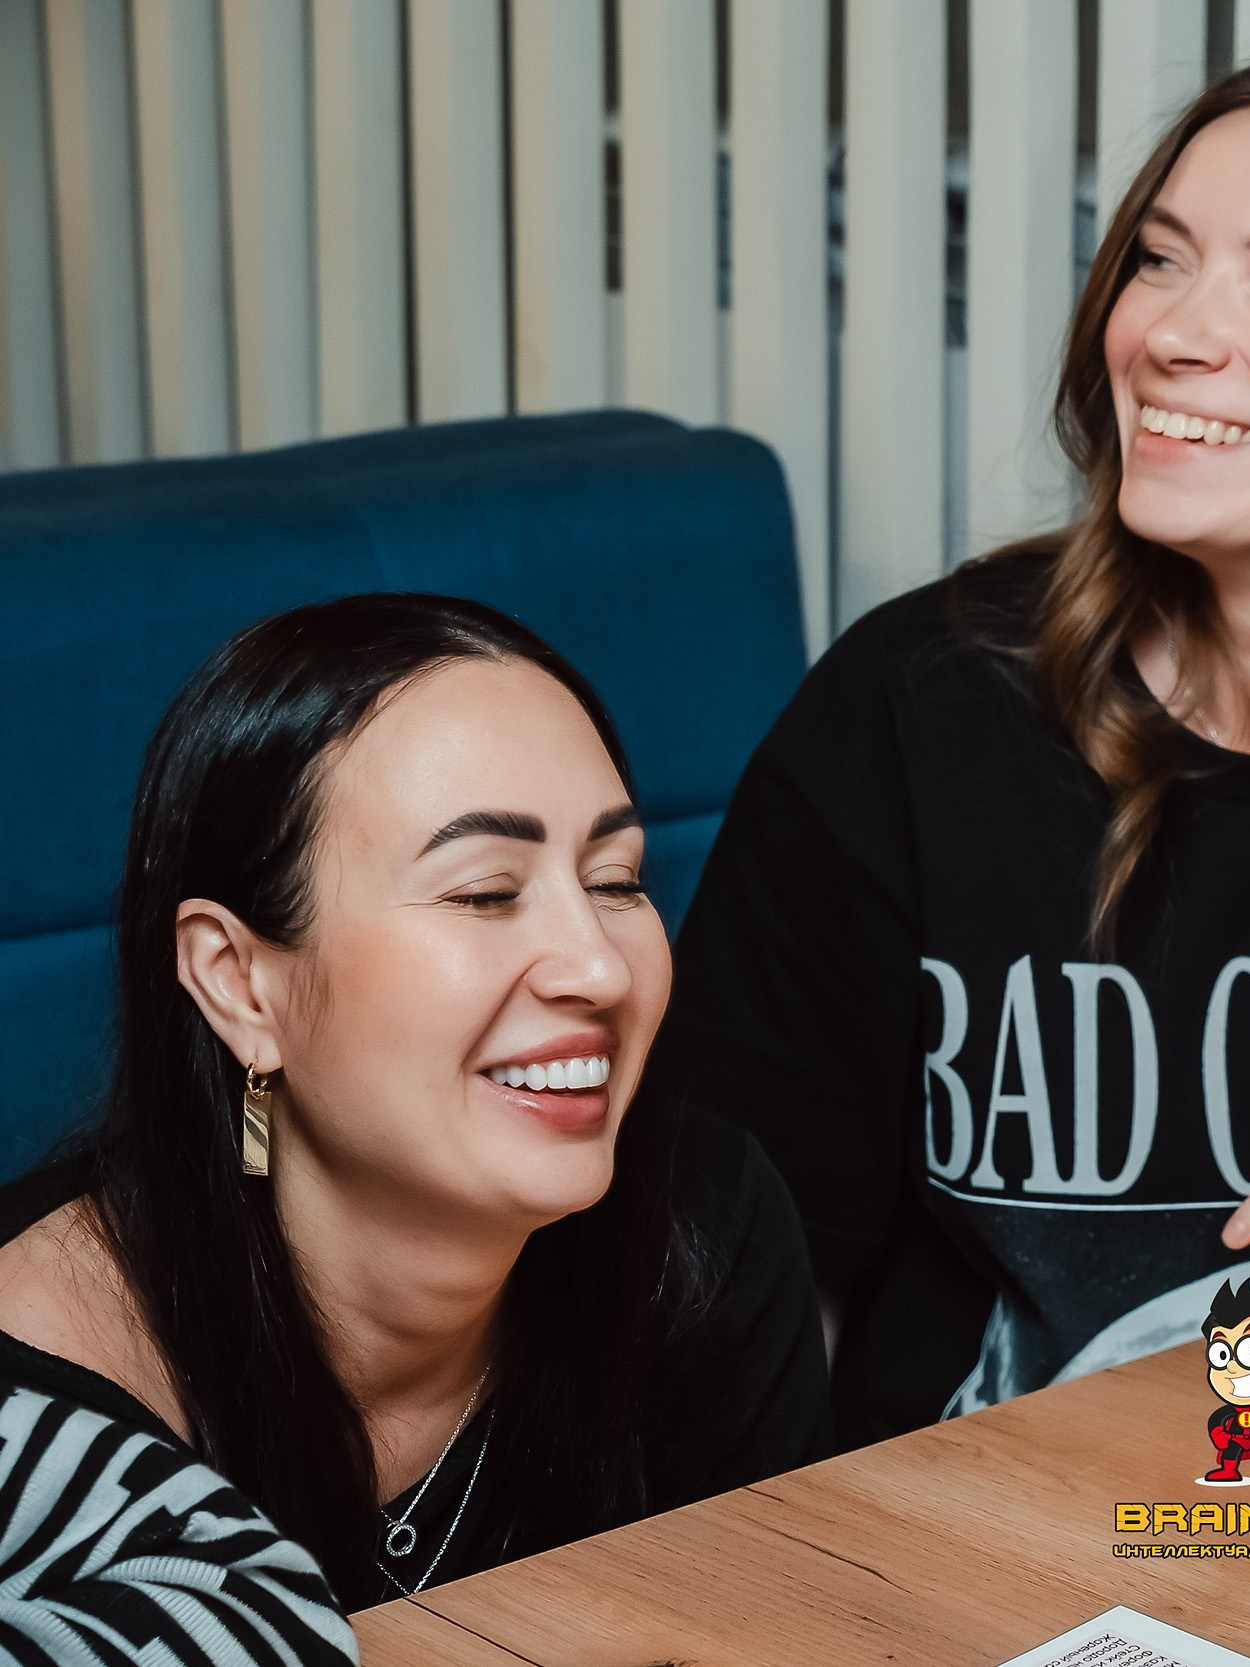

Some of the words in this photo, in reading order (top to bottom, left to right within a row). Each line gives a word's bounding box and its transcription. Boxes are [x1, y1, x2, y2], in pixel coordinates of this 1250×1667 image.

[921, 953, 1159, 1195] BAD
[1060, 1633, 1116, 1662] Жареный
[1082, 1638, 1127, 1663] Дорадо
[1104, 1645, 1141, 1663] Стейк
